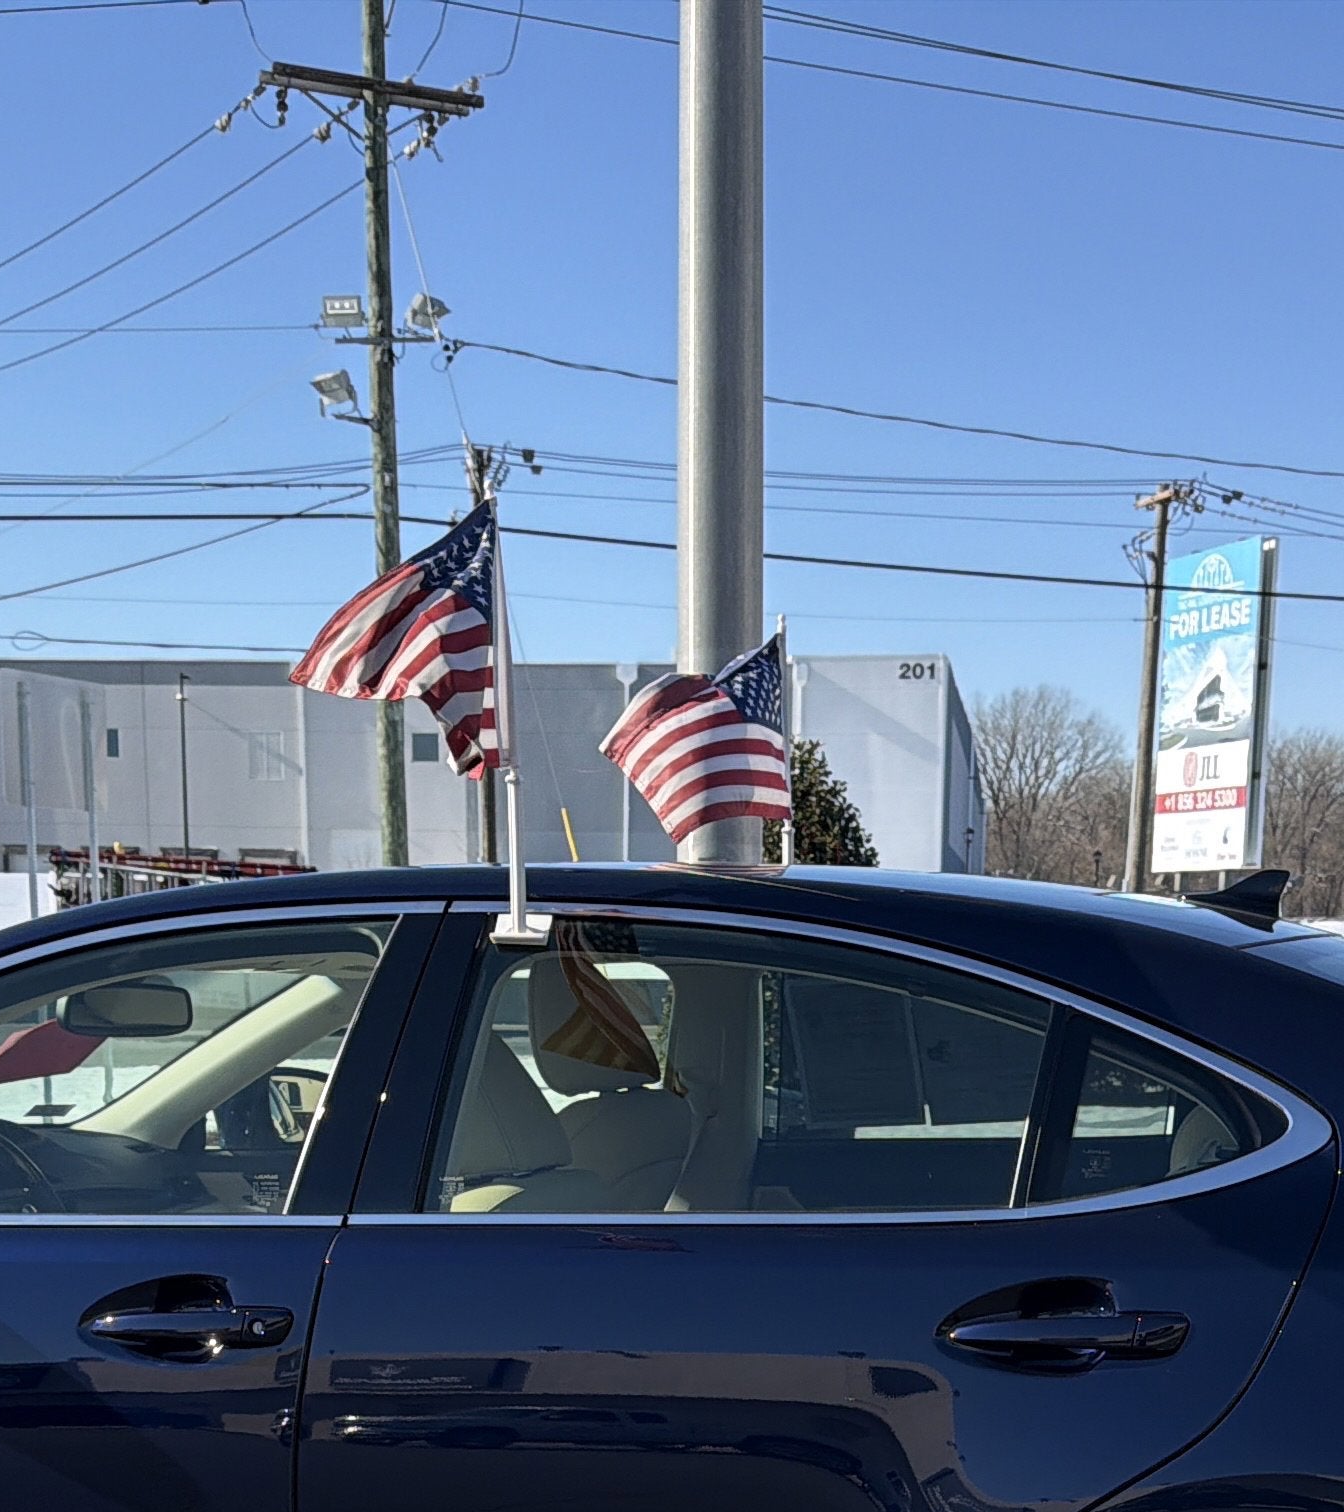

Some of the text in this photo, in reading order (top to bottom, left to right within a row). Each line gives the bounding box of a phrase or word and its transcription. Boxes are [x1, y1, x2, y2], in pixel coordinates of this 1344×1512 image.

[1169, 610, 1200, 640] FOR
[1201, 598, 1251, 633] LEASE
[898, 662, 936, 680] 201
[1199, 755, 1220, 781] JLL
